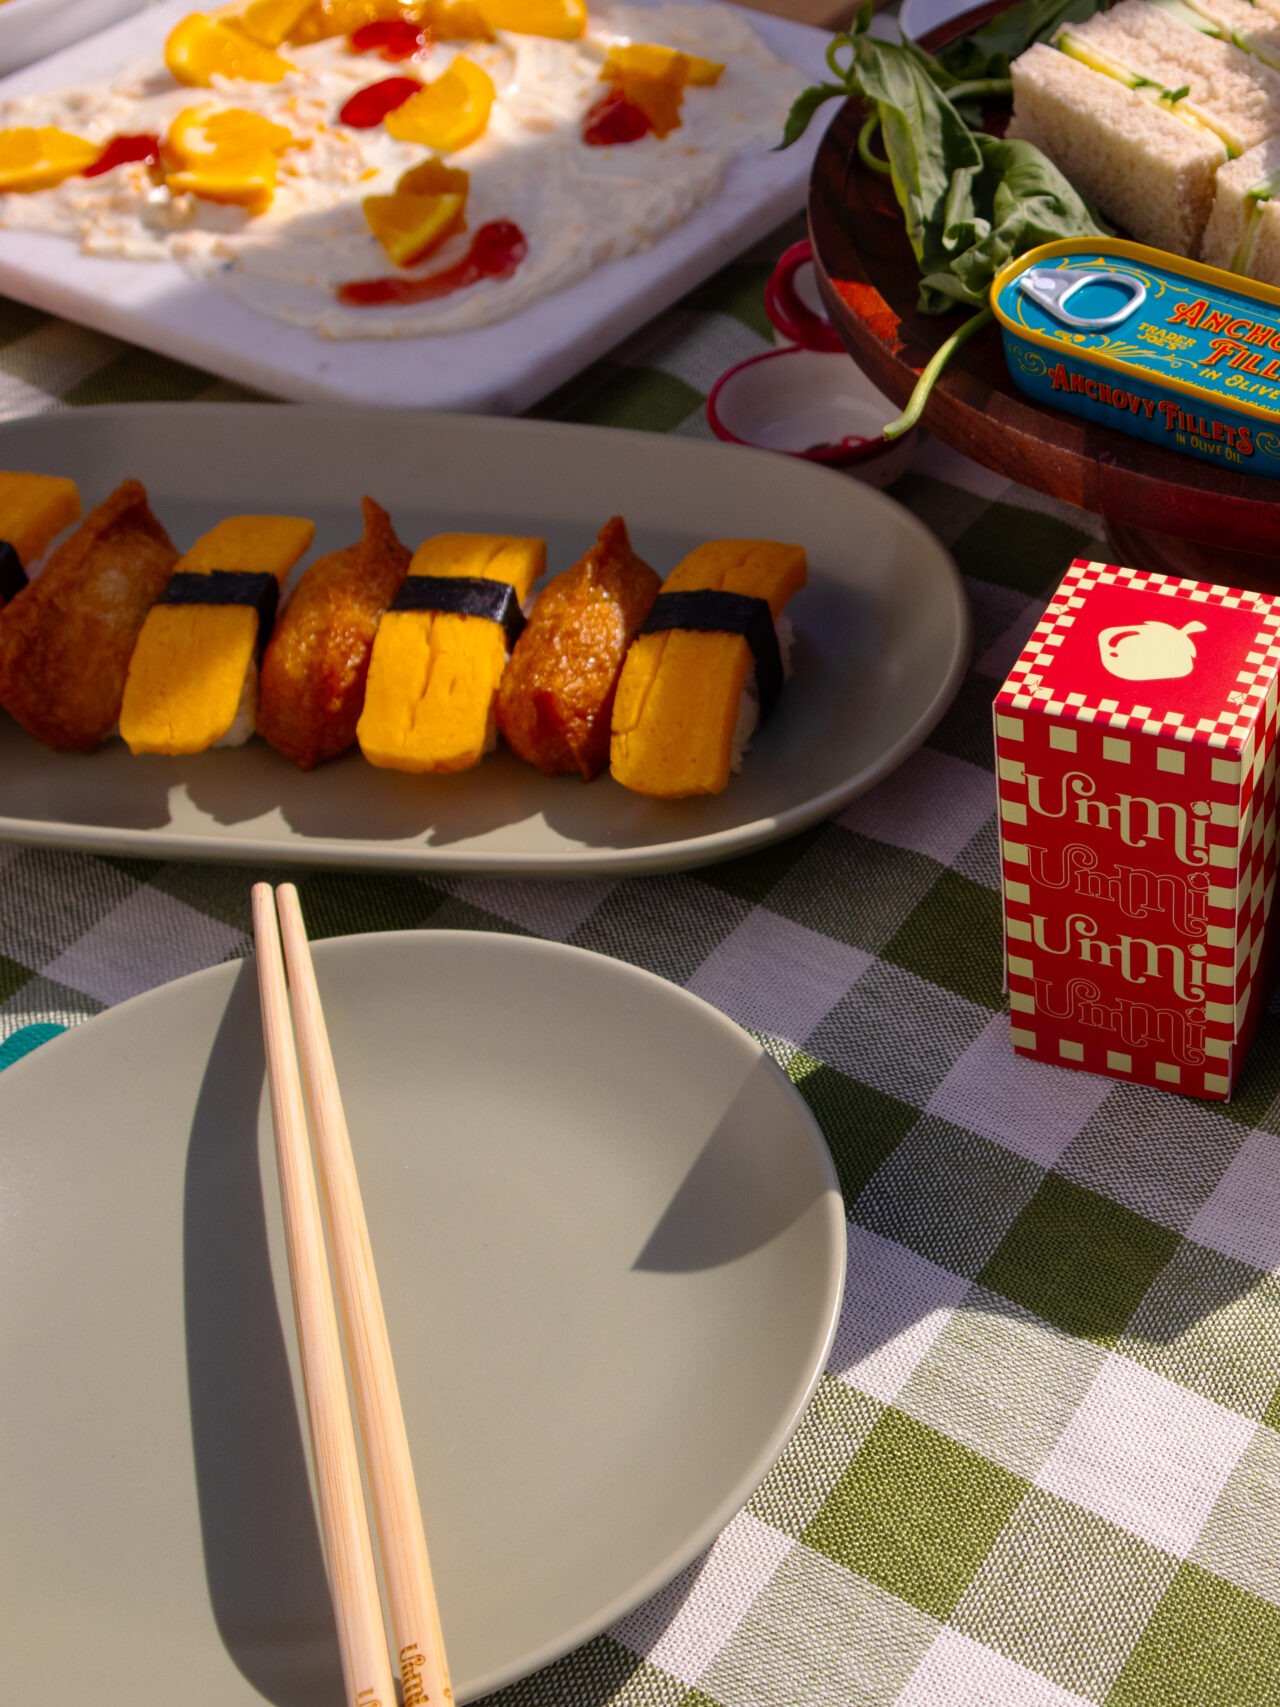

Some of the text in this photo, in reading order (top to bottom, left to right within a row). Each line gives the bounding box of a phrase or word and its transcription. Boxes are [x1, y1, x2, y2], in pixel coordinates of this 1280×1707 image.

[1137, 322, 1197, 347] TRADER
[1198, 368, 1223, 380] IN
[1048, 363, 1155, 419] ANCHOVY
[1158, 400, 1253, 455] FILLETS
[1176, 432, 1243, 464] IN OLIVE OIL
